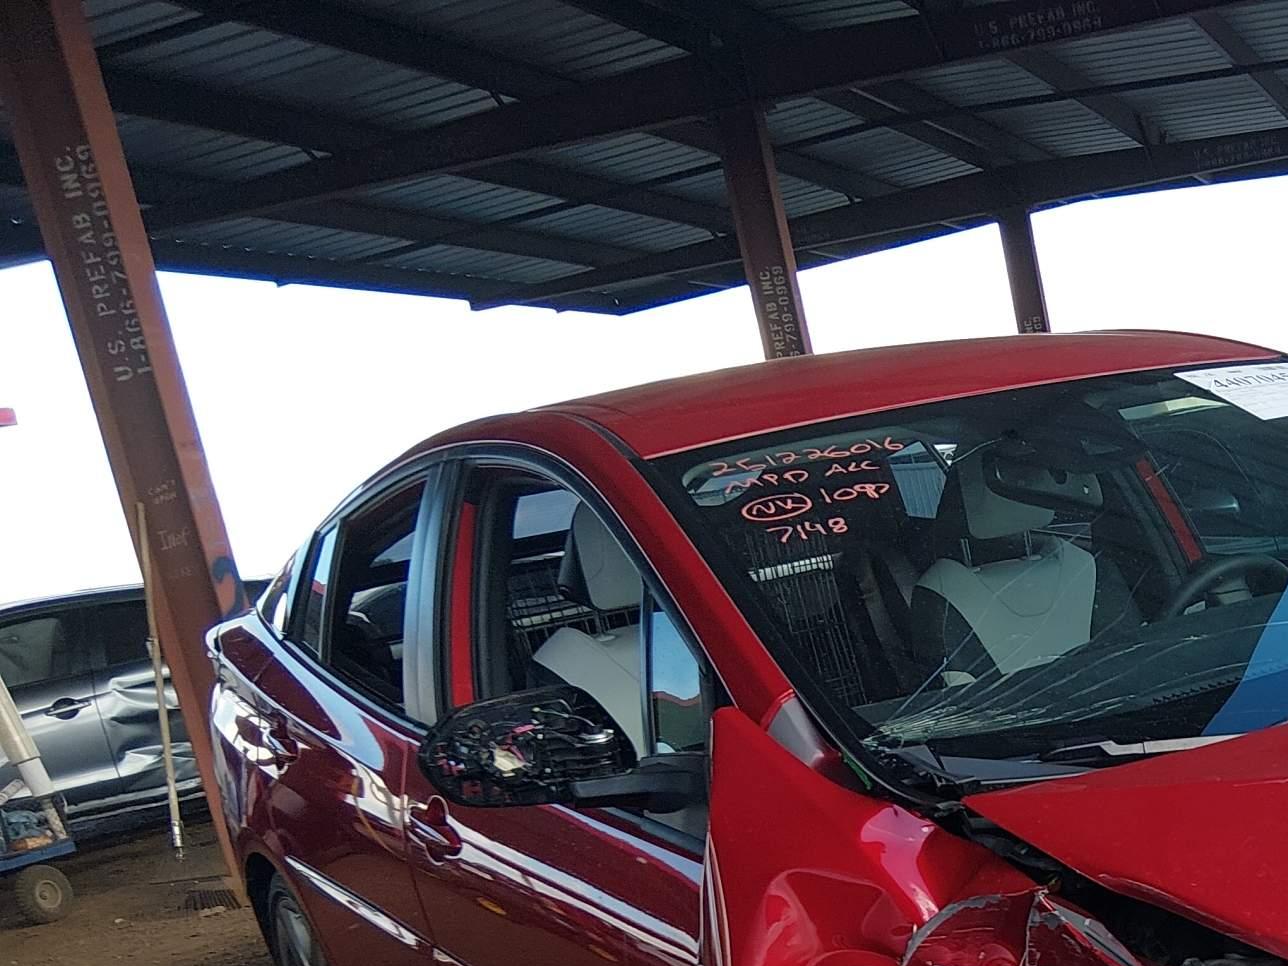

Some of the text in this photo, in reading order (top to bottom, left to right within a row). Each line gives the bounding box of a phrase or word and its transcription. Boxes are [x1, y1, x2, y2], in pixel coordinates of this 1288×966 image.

[56, 146, 135, 382] U.S. PREFAB INC.
[760, 266, 775, 295] INC.
[711, 437, 904, 476] 251226016
[724, 470, 809, 494] MPD
[767, 517, 849, 543] 7148
